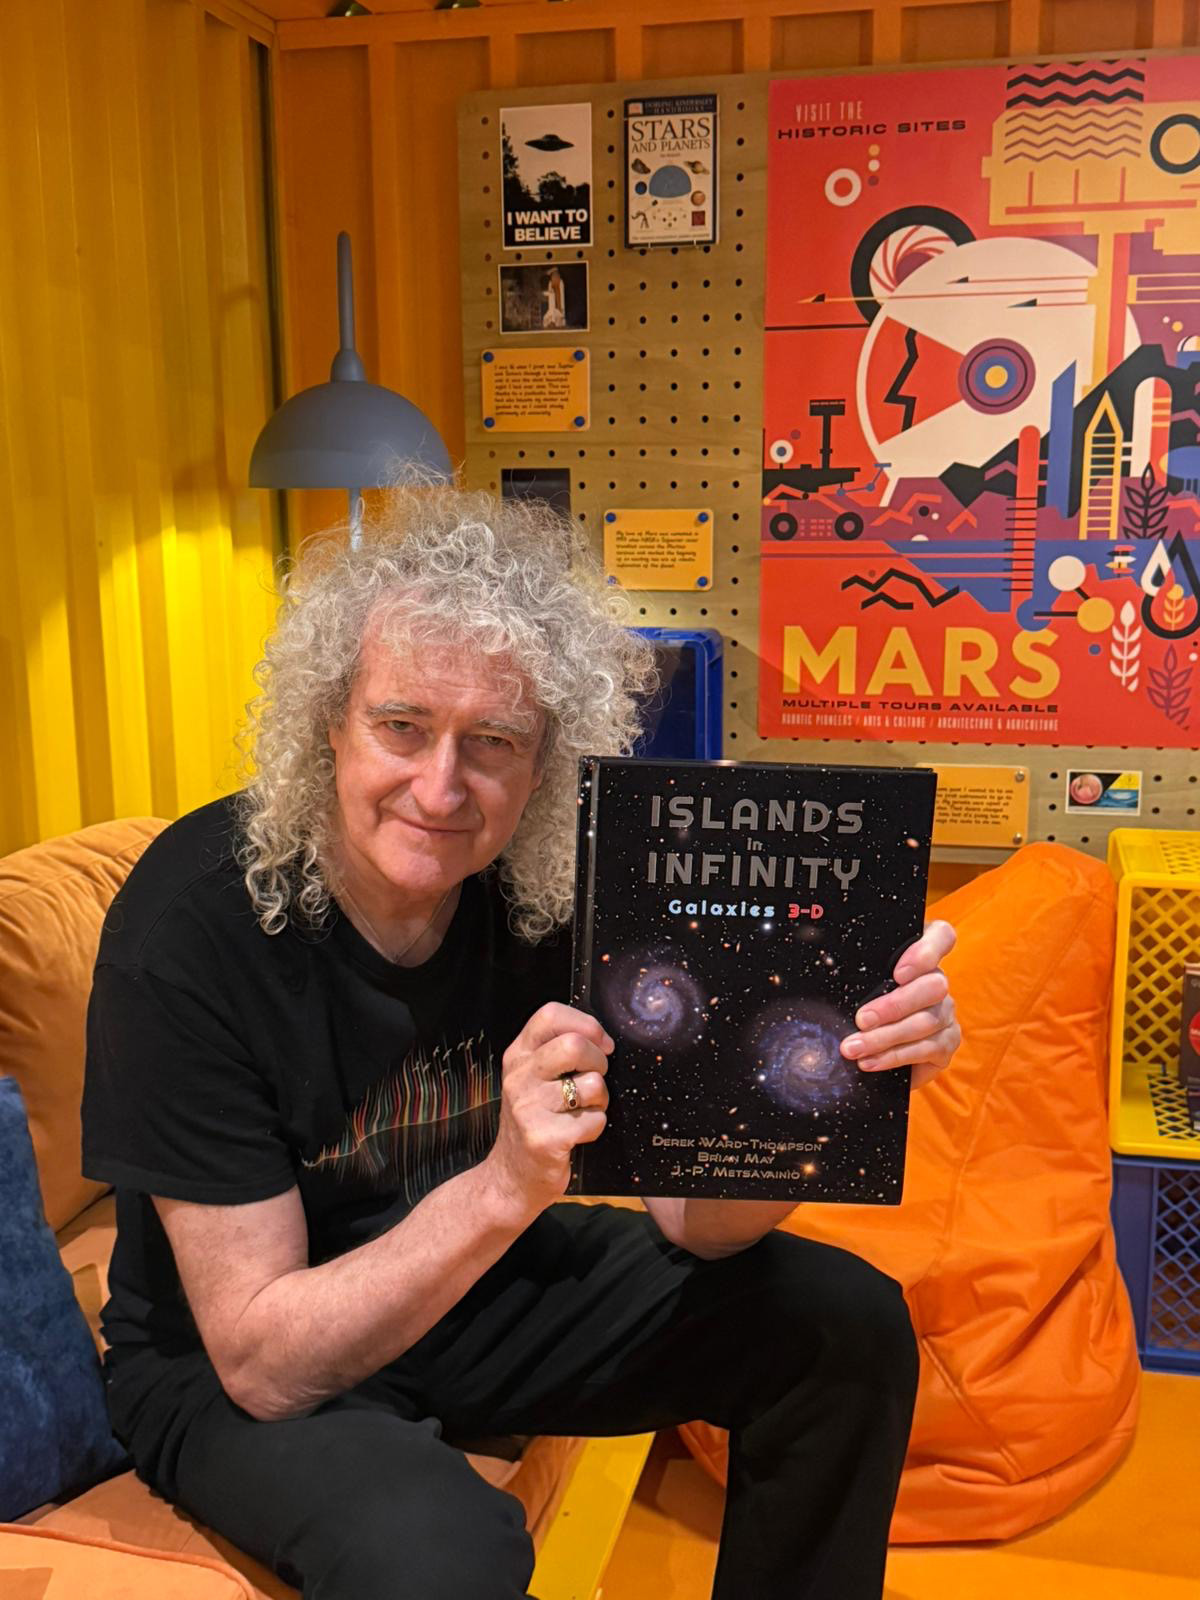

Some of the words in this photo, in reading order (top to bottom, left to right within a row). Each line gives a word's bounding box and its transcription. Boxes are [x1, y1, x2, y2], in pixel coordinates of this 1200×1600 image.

[796, 103, 830, 122] VISIT
[840, 100, 862, 120] THE
[632, 117, 711, 142] STARS
[778, 124, 887, 139] HISTORIC
[897, 120, 966, 133] SITES
[632, 142, 657, 153] AND
[660, 139, 711, 152] PLANETS
[507, 211, 513, 226] I
[515, 209, 563, 225] WANT
[565, 208, 588, 223] TO
[514, 226, 582, 242] BELIEVE
[782, 625, 1061, 699] MARS
[782, 699, 871, 709] MULTIPLE
[878, 701, 942, 710] TOURS
[949, 703, 1058, 713] AVAILABLE
[782, 713, 812, 725] ROBOTIC
[816, 714, 852, 726] PIONEERS
[863, 715, 881, 727] ARTS
[893, 716, 925, 729] CULTURE
[938, 717, 993, 730] ARCHITECTURE
[650, 795, 863, 834] ISLANDS
[647, 852, 861, 890] INFINITY
[668, 899, 775, 918] Galaxies
[788, 903, 824, 919] 3-D
